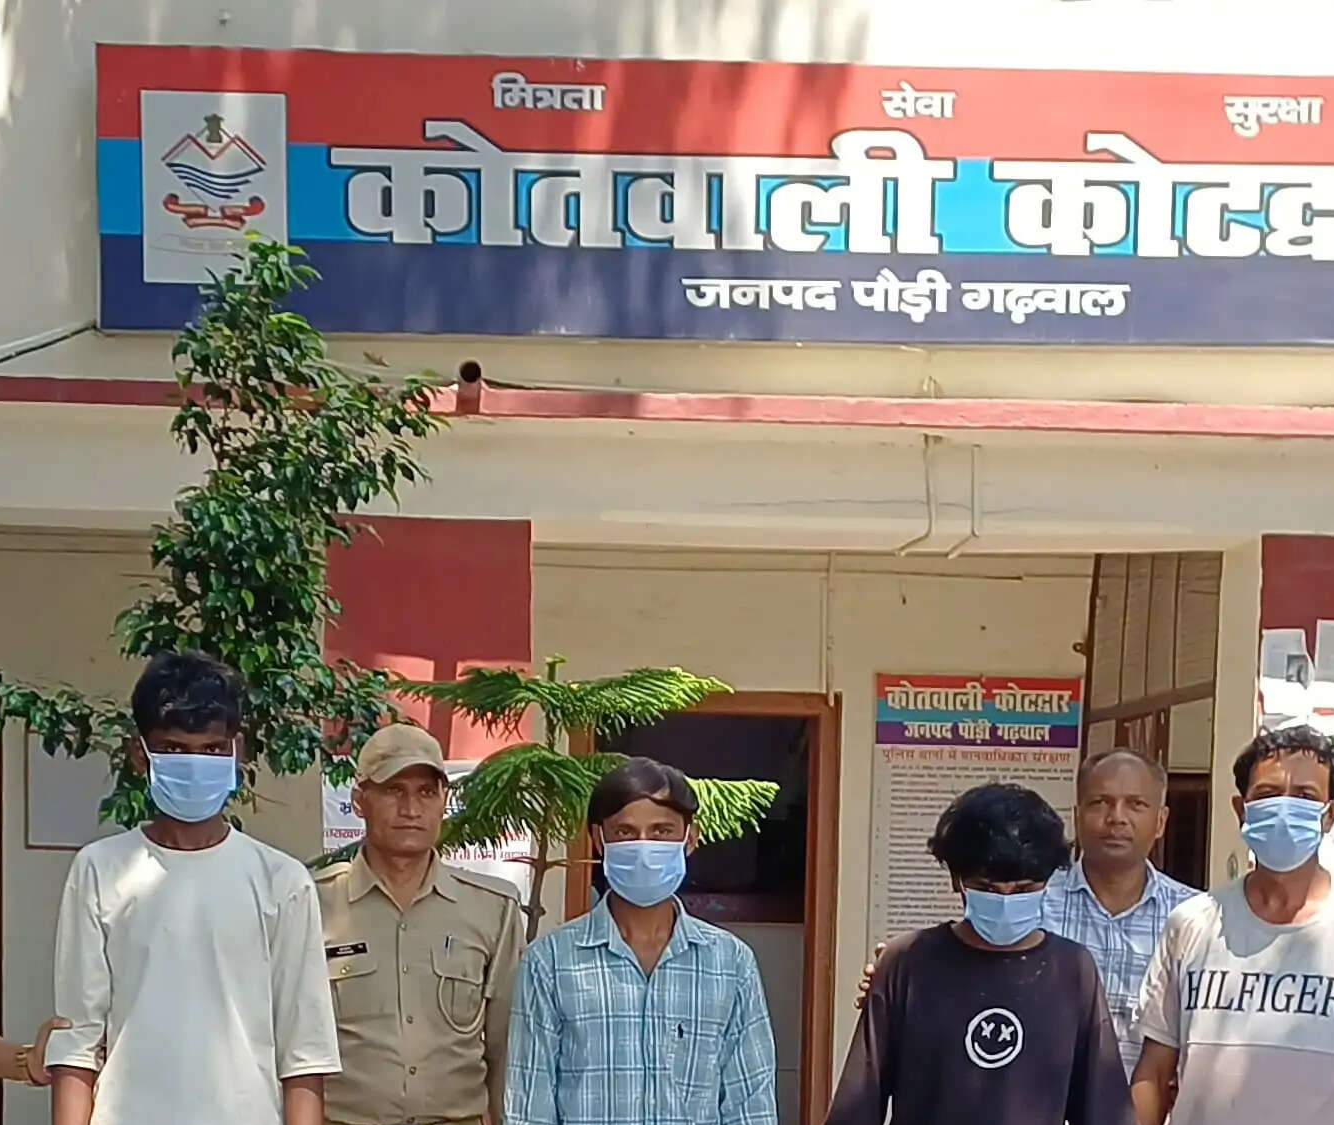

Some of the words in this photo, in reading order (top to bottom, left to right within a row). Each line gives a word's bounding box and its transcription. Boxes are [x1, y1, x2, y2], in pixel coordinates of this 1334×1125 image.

[491, 73, 606, 112] मित्रता
[881, 81, 957, 119] सेवा
[1223, 91, 1326, 137] सुरक्षा
[328, 119, 957, 256] कोतवाली
[682, 274, 839, 312] जनपद
[850, 267, 951, 324] पौड़ी
[961, 280, 1132, 323] गढ़वाल
[884, 680, 986, 712] कोतवाली
[991, 682, 1073, 714] कोटद्वार
[903, 720, 954, 739] जनपद
